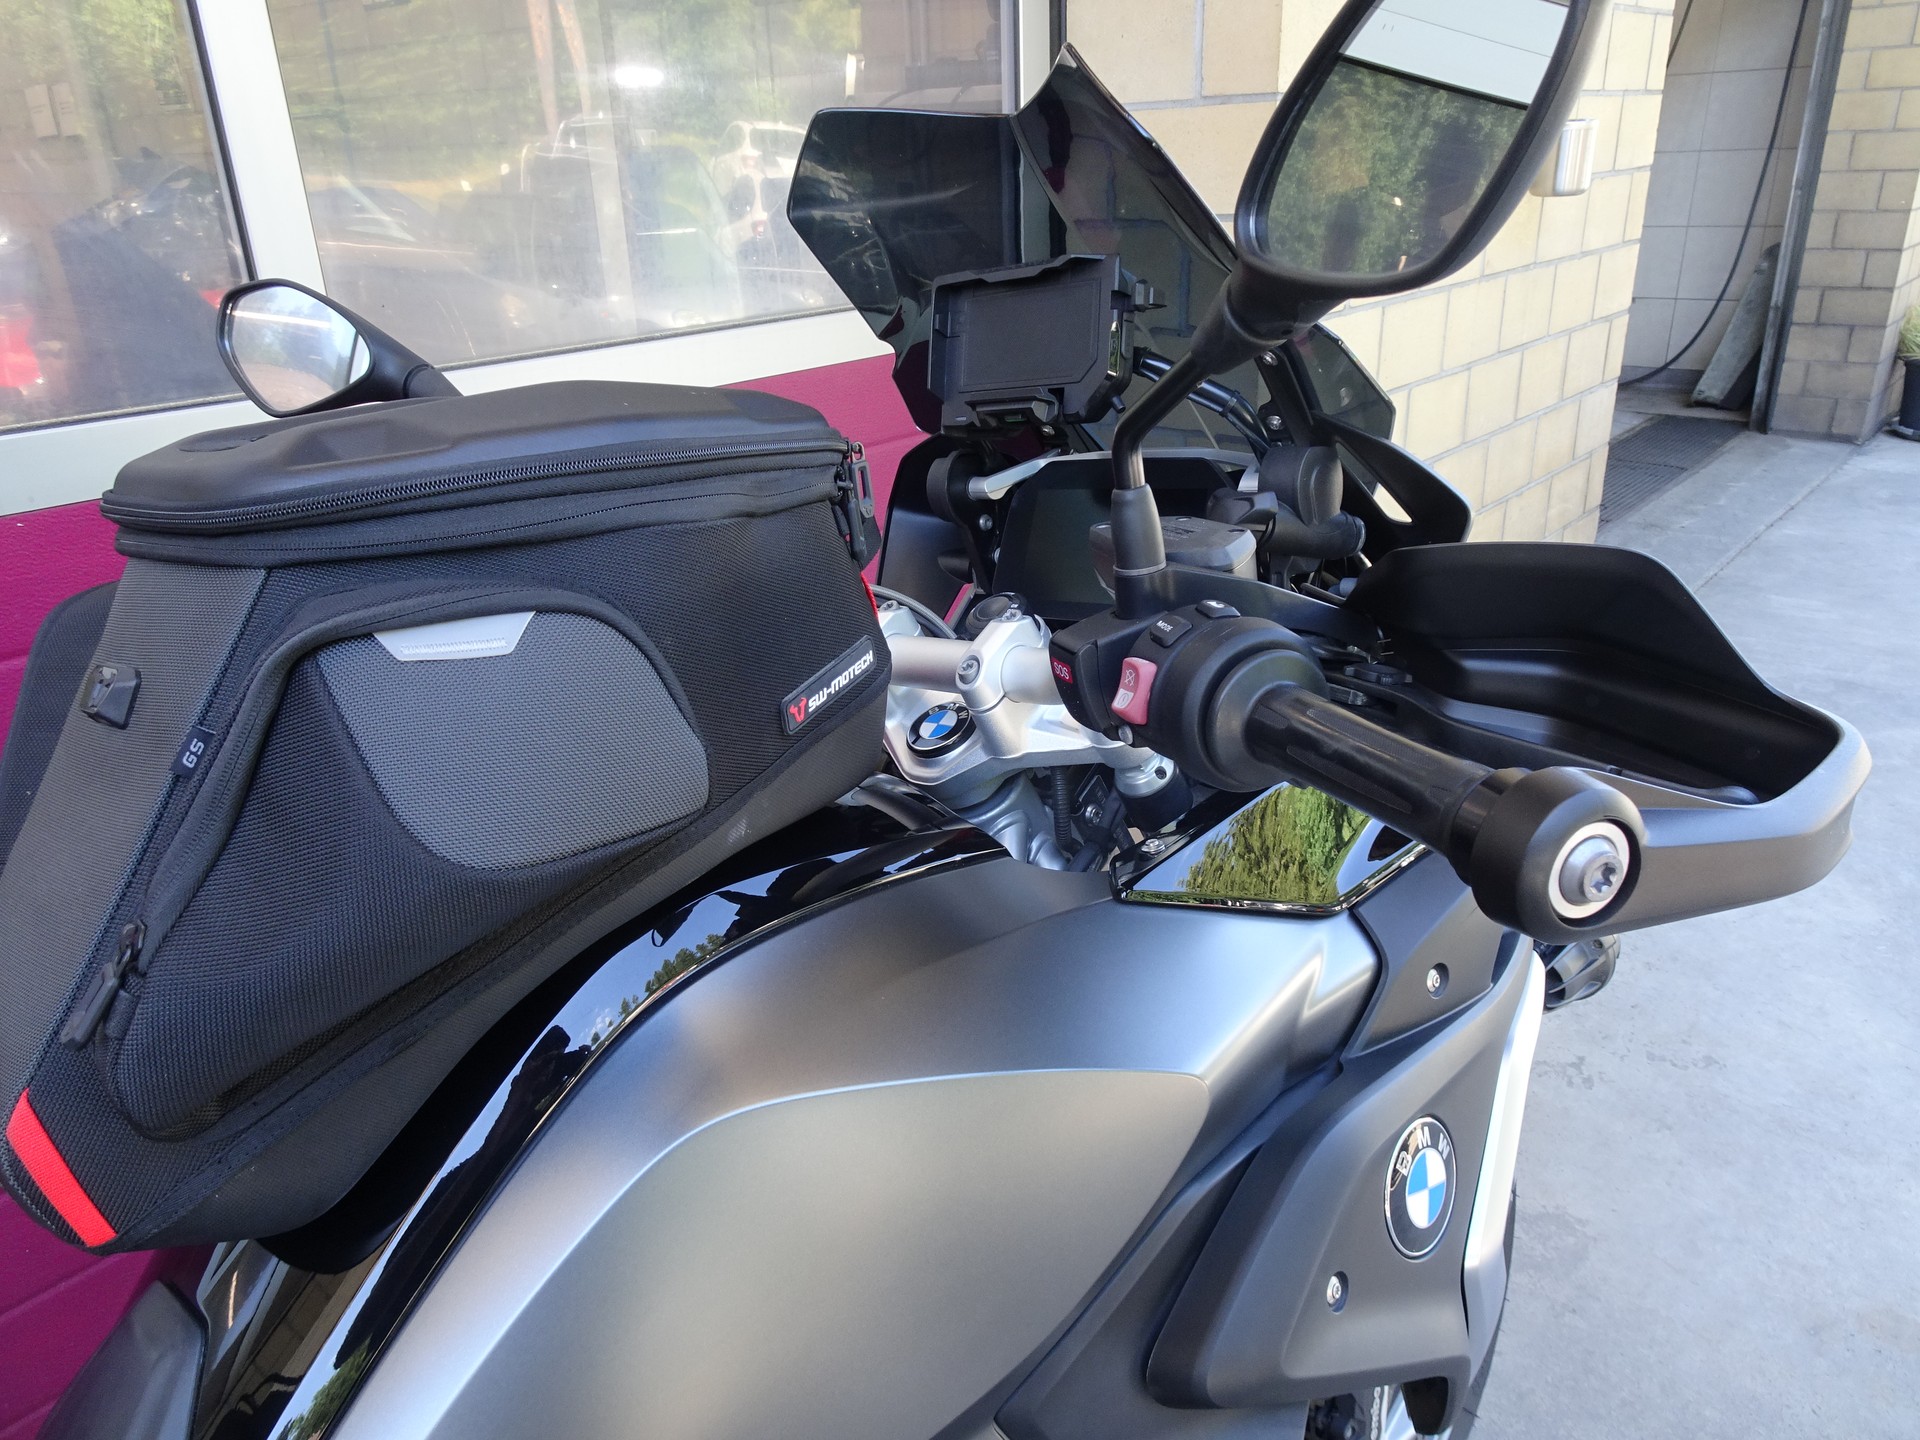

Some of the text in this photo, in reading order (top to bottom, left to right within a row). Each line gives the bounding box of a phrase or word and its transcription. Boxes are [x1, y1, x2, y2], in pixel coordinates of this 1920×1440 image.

[1156, 620, 1173, 632] MODE
[808, 650, 874, 713] SW-MOTECH
[1053, 661, 1070, 680] SOS
[928, 703, 969, 720] BMW
[182, 738, 205, 769] GS
[1396, 1125, 1451, 1177] BMW
